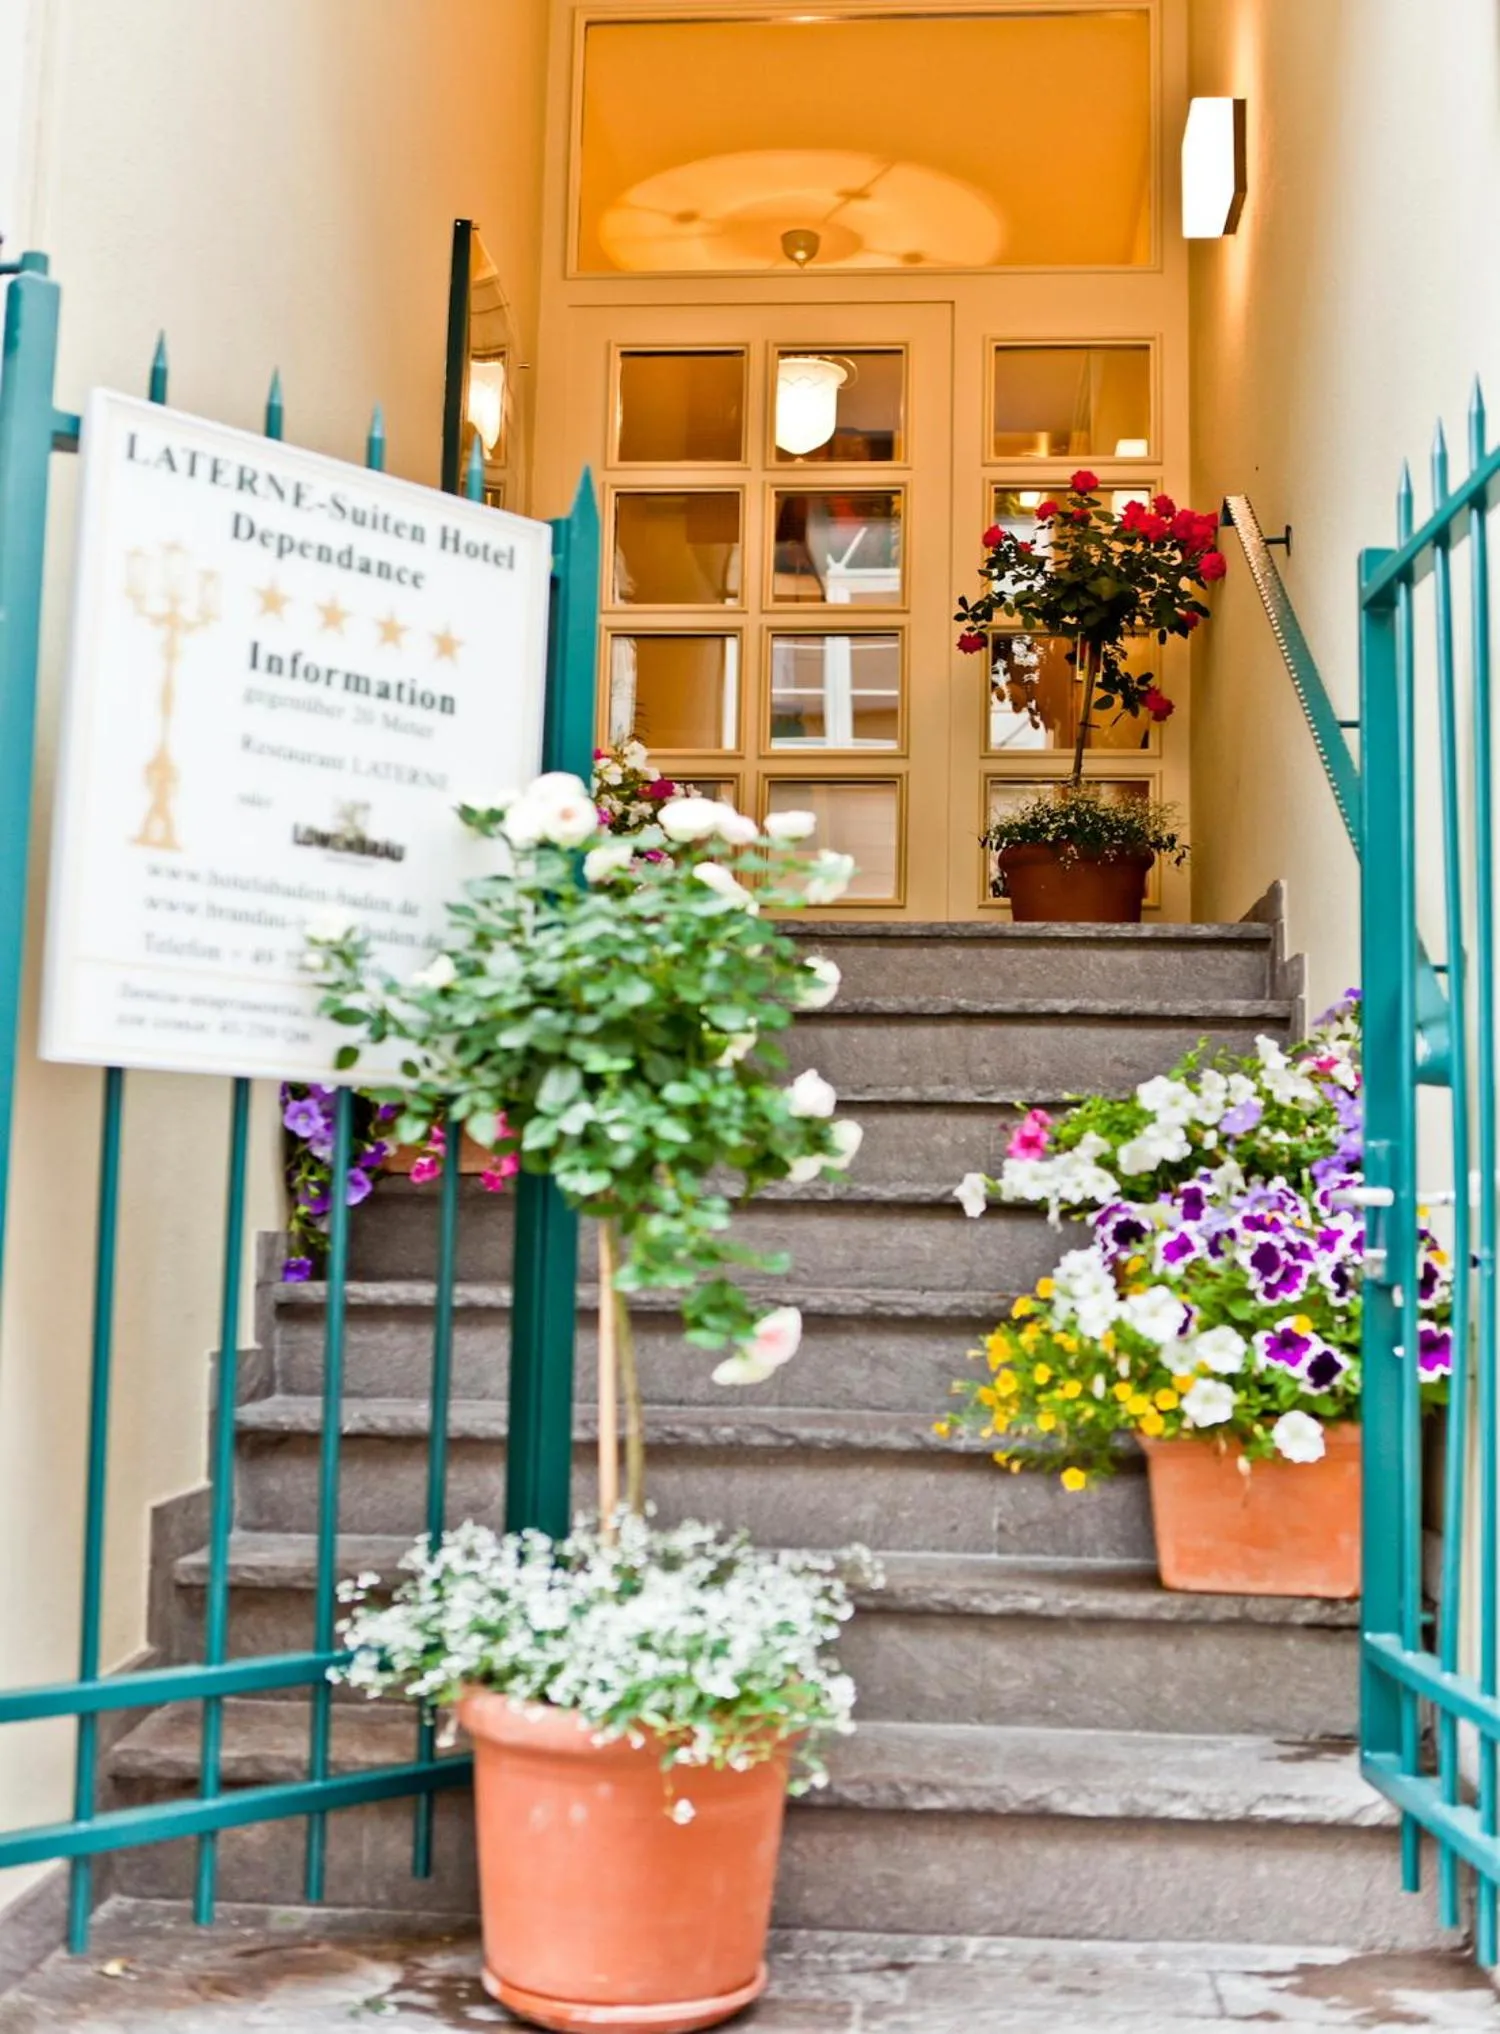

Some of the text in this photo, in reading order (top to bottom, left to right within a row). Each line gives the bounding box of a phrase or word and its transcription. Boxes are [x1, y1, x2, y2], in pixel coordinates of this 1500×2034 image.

[124, 431, 517, 571] LATERNE-Suiten Hotel
[230, 512, 427, 590] Dependance
[248, 640, 456, 715] Information
[240, 733, 347, 770] Restaurant
[144, 932, 221, 960] Telefon
